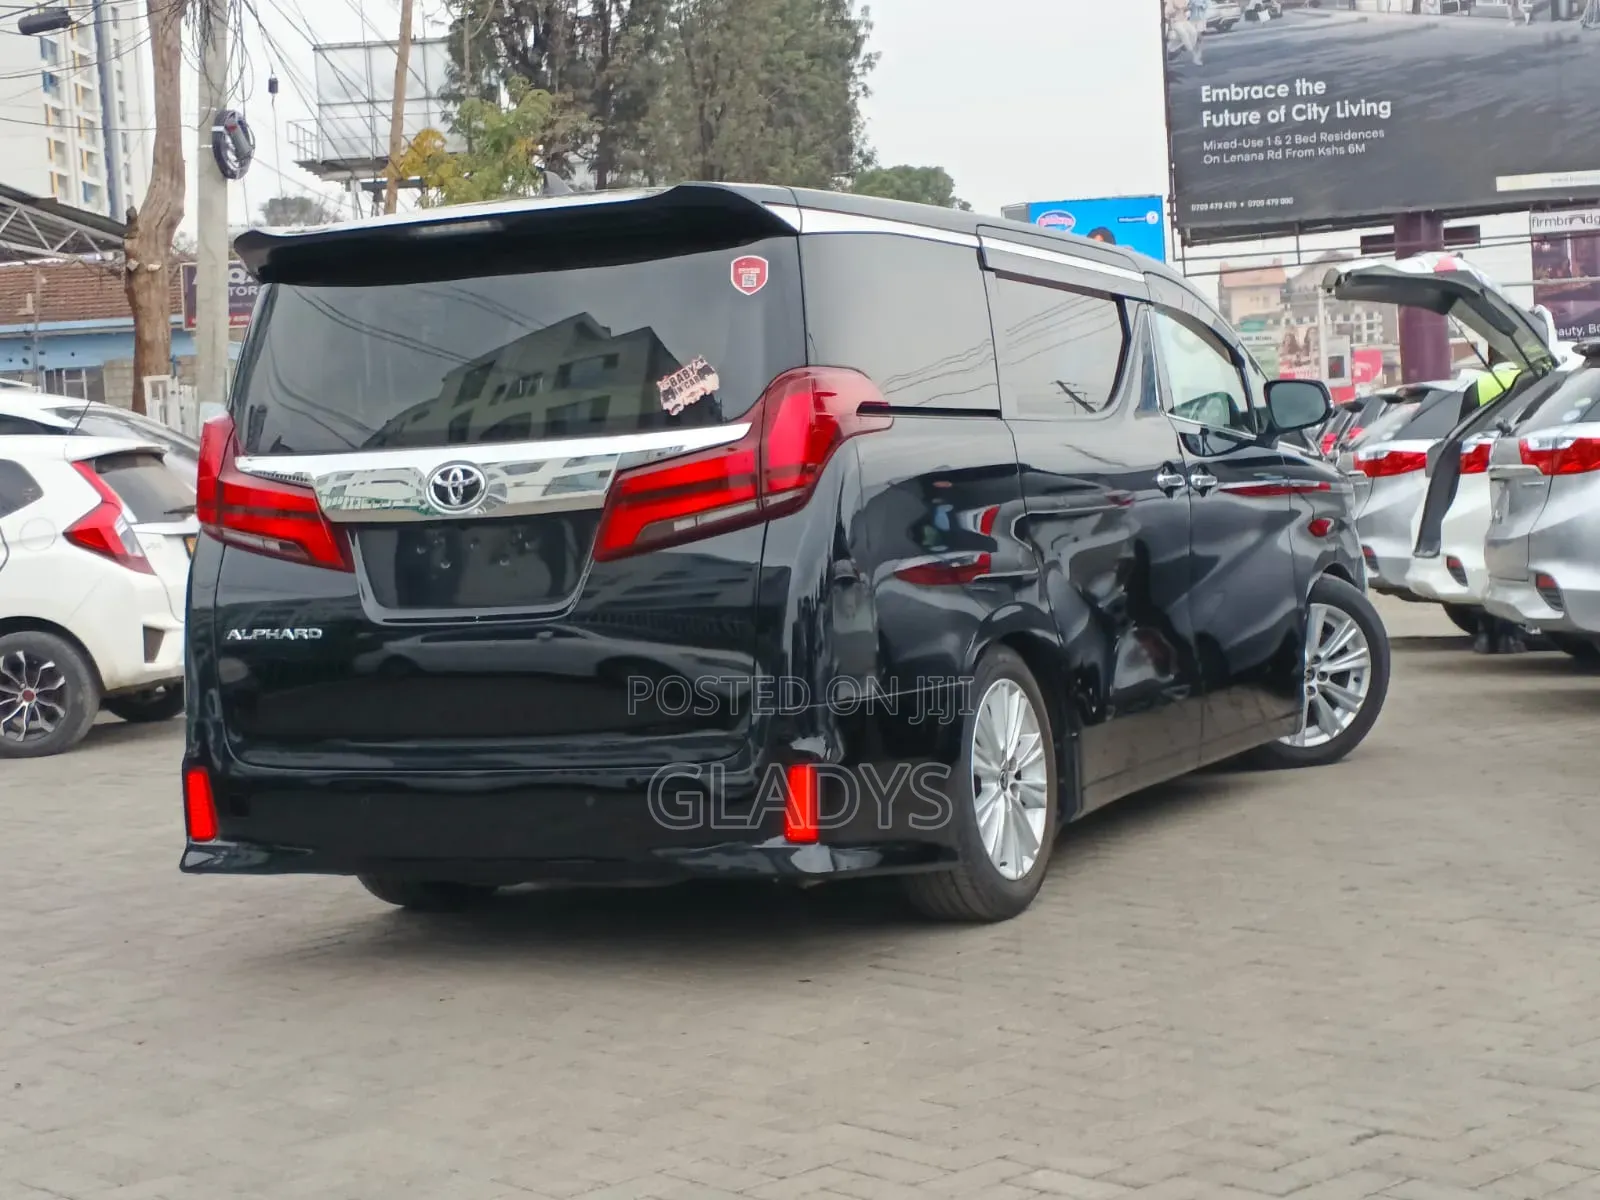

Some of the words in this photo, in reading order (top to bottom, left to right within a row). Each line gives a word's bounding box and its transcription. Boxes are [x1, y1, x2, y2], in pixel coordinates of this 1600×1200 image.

[1201, 84, 1289, 102] Embrace
[1295, 78, 1326, 96] the
[1202, 109, 1261, 127] Future
[1267, 105, 1285, 123] of
[1292, 103, 1330, 123] City
[1336, 99, 1391, 119] Living
[1203, 137, 1263, 151] Mixed-Use
[1266, 137, 1271, 146] 1
[1274, 135, 1282, 145] &
[1285, 135, 1292, 145] 2
[1295, 132, 1316, 144] Bed
[1320, 129, 1385, 142] Residences
[1203, 153, 1220, 165] On
[1223, 152, 1264, 163] Lenana
[1267, 149, 1282, 160] Rd
[1286, 148, 1315, 159] From
[1318, 145, 1345, 156] Kshs
[1348, 143, 1366, 154] 6M
[1558, 325, 1585, 337] auty,
[226, 628, 322, 640] ALPHARD
